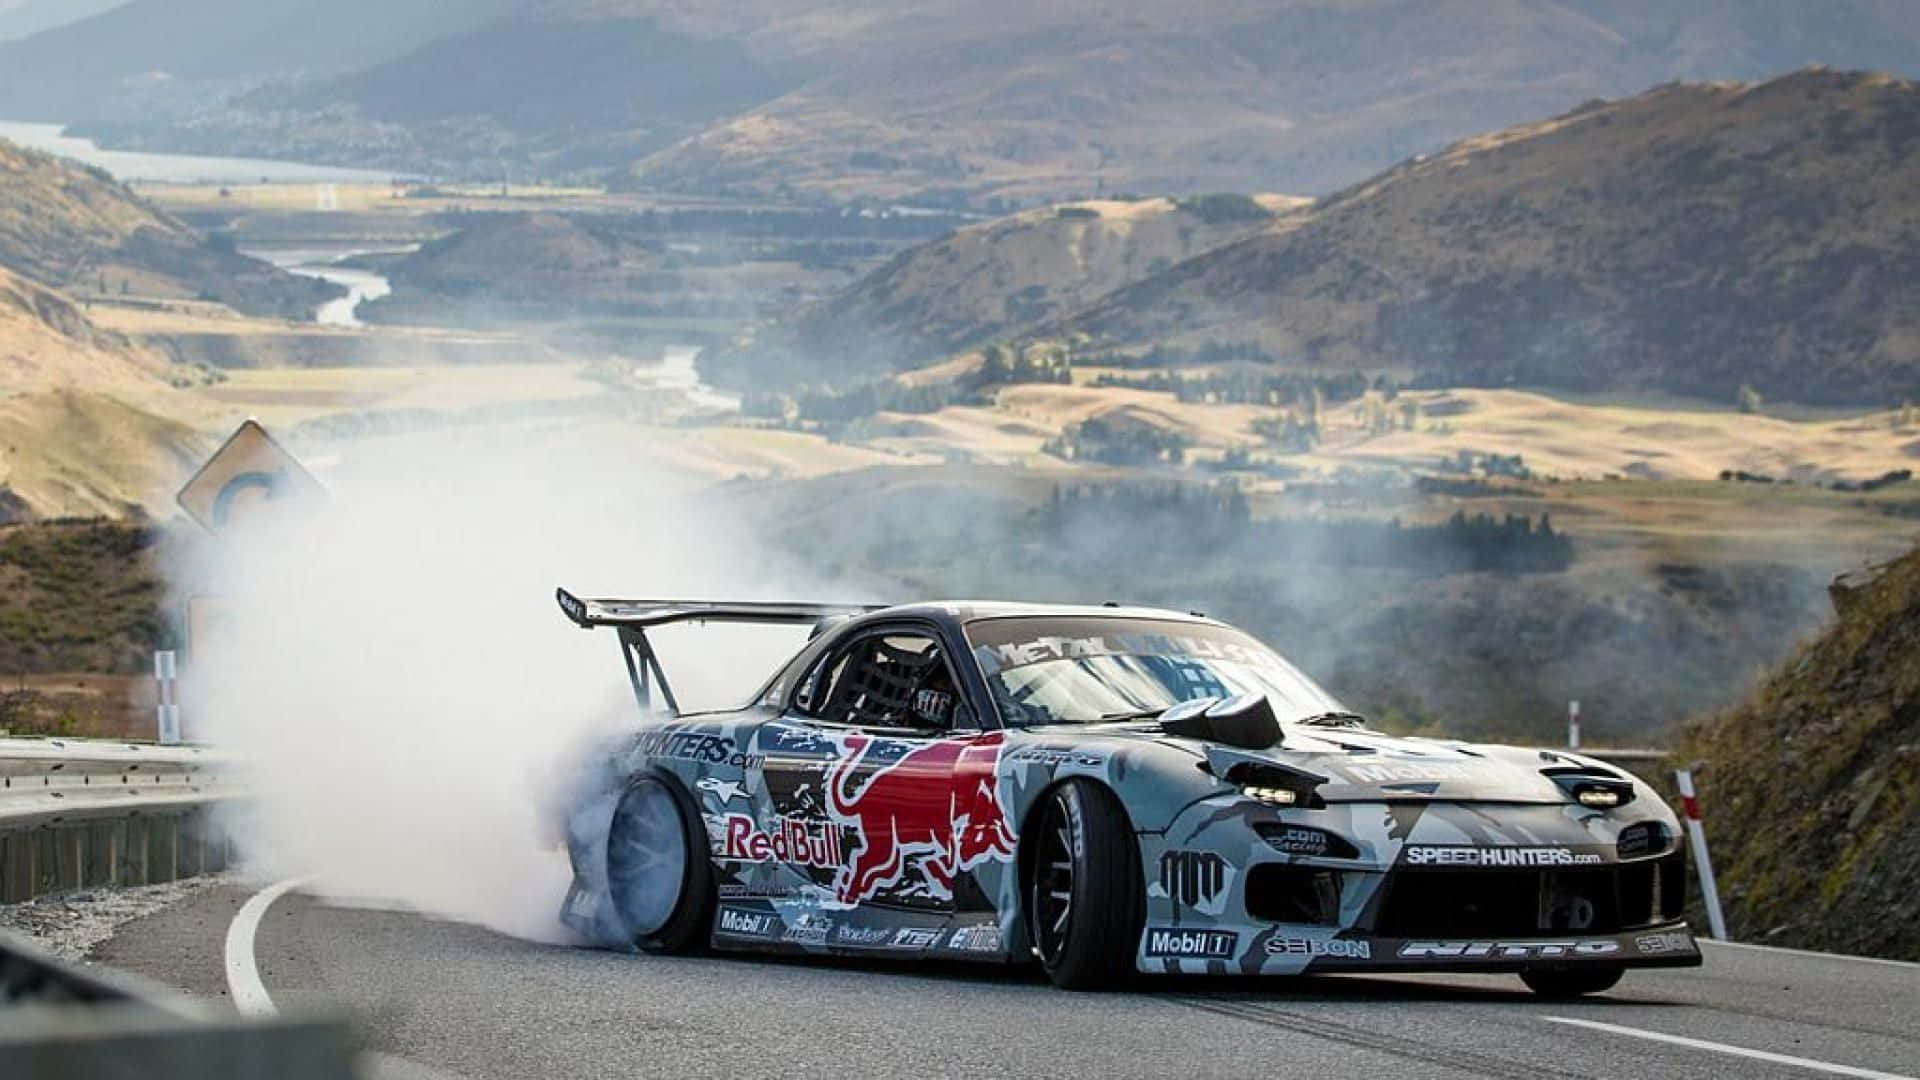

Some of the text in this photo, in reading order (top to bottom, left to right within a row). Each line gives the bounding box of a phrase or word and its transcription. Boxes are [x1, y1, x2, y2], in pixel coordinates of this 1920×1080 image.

[1407, 847, 1601, 865] SPEEDHUNTERS.com
[721, 909, 763, 932] Mobil
[1151, 932, 1206, 954] Mobil
[1264, 936, 1371, 959] SEIBON
[1398, 940, 1620, 956] NITTO
